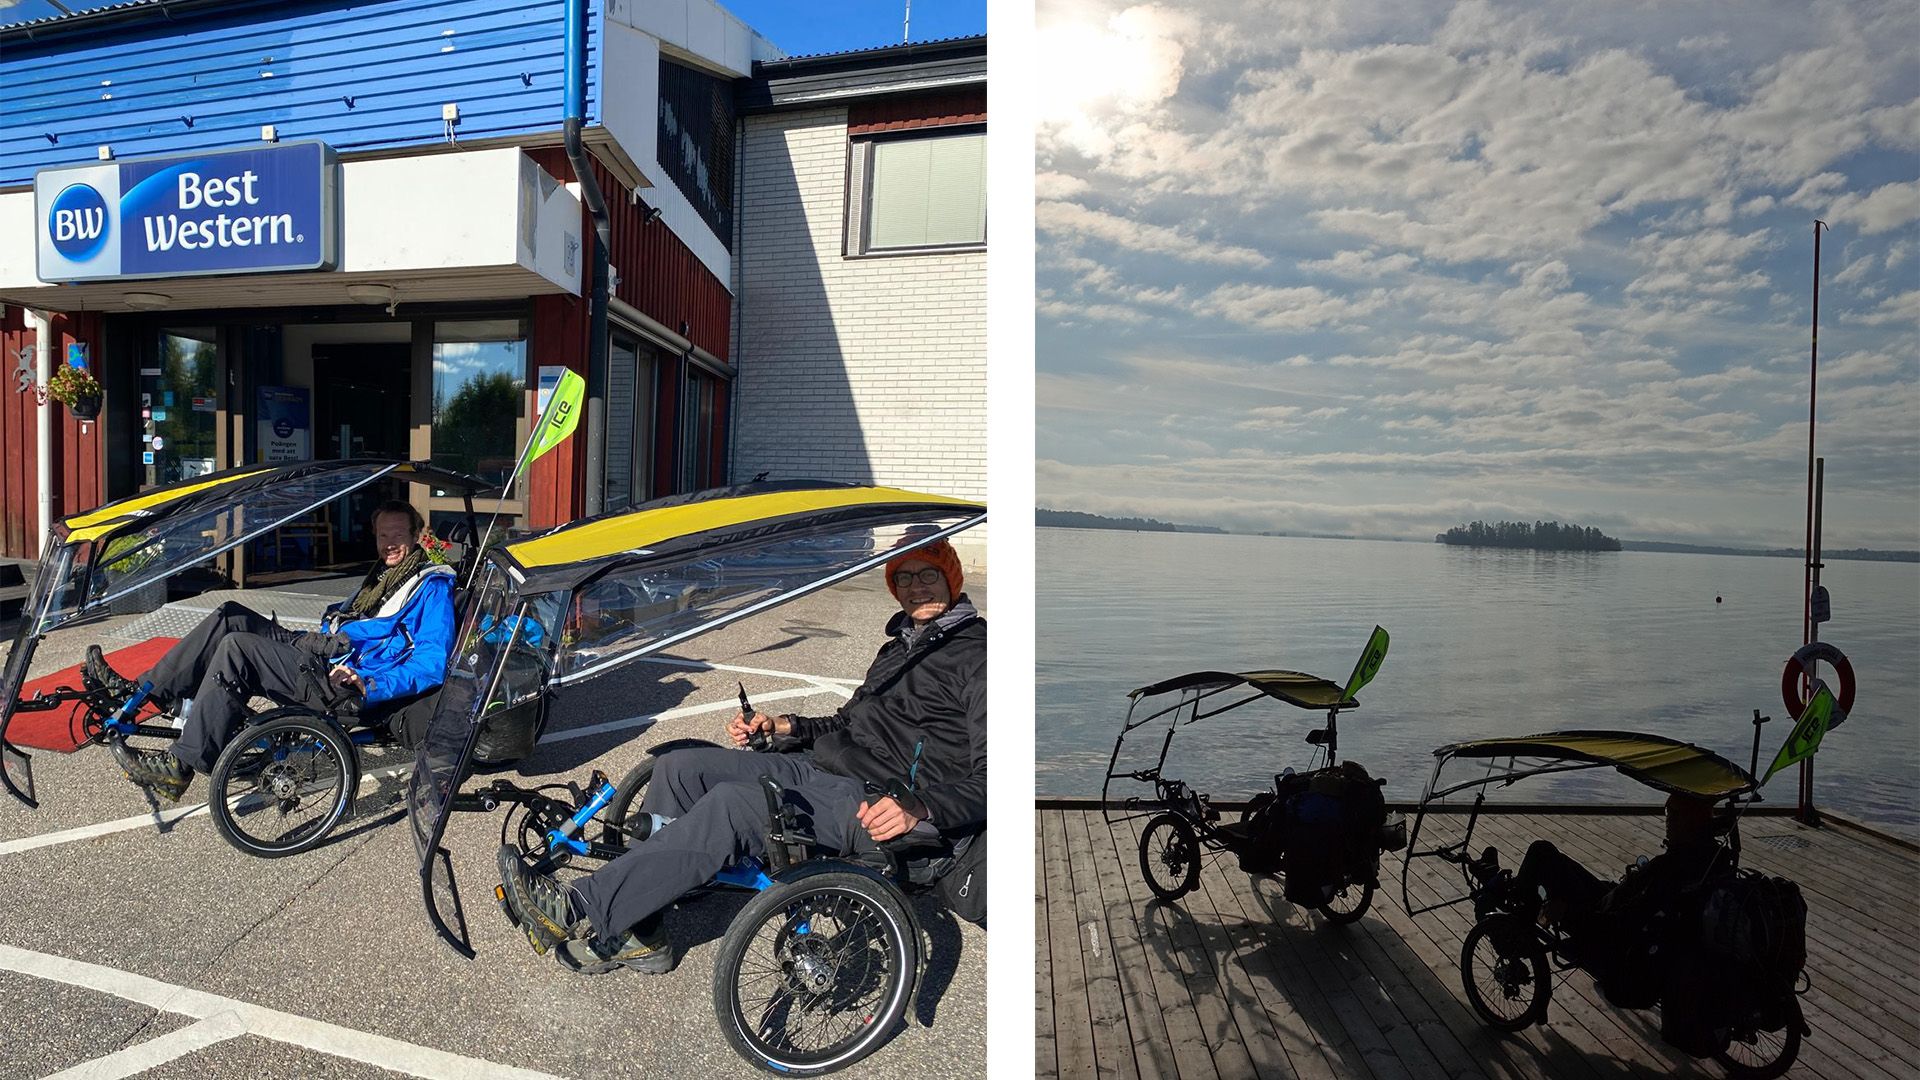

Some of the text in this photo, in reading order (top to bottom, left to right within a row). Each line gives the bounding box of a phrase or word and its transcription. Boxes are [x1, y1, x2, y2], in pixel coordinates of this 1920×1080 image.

[178, 170, 259, 209] Best
[55, 206, 104, 241] BW
[143, 213, 295, 251] Western
